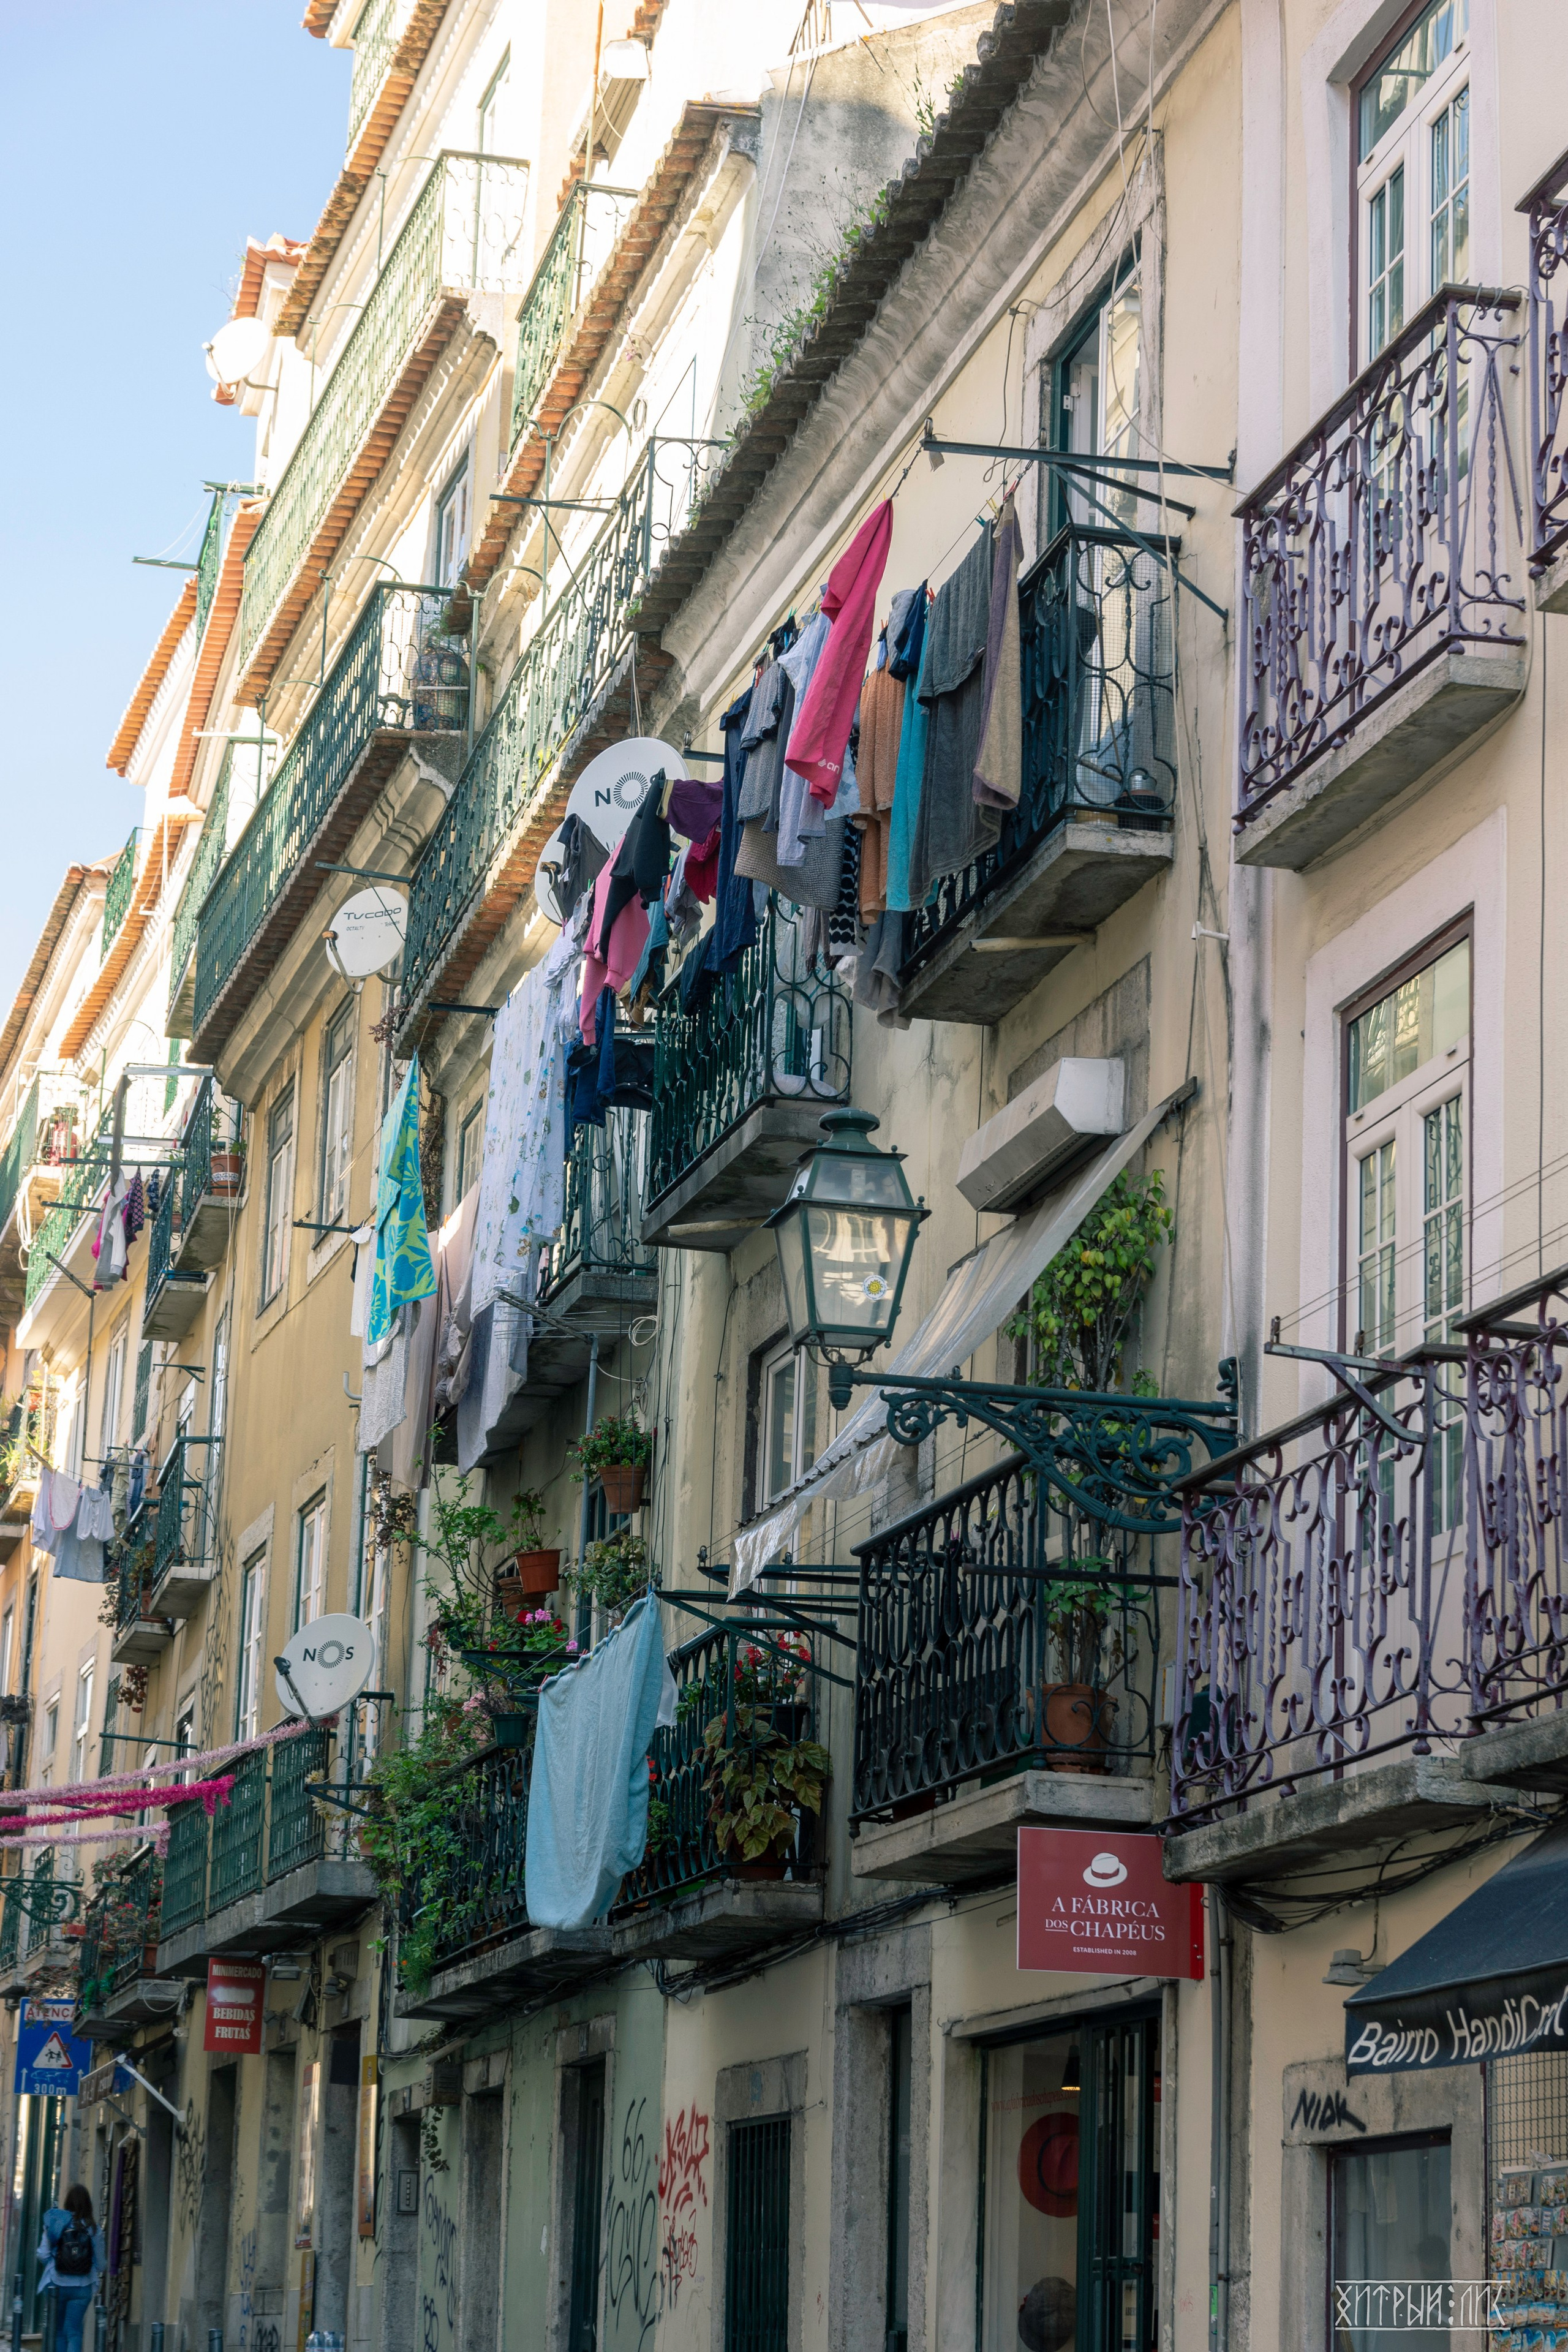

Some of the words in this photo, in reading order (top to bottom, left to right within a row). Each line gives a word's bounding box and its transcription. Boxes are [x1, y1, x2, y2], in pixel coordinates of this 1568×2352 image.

[303, 1640, 355, 1669] NOS
[1051, 1896, 1066, 1913] A
[1071, 1894, 1160, 1918] FÁBRICA
[1045, 1919, 1068, 1929] DOS
[1069, 1920, 1166, 1942] CHAPÉUS
[1072, 1946, 1114, 1955] ESTABLISHED
[212, 1964, 263, 1979] MINIMERCADO
[213, 2007, 255, 2021] BEBIDAS
[214, 2026, 251, 2040] FRUTAS
[1348, 2019, 1440, 2067] Bairro
